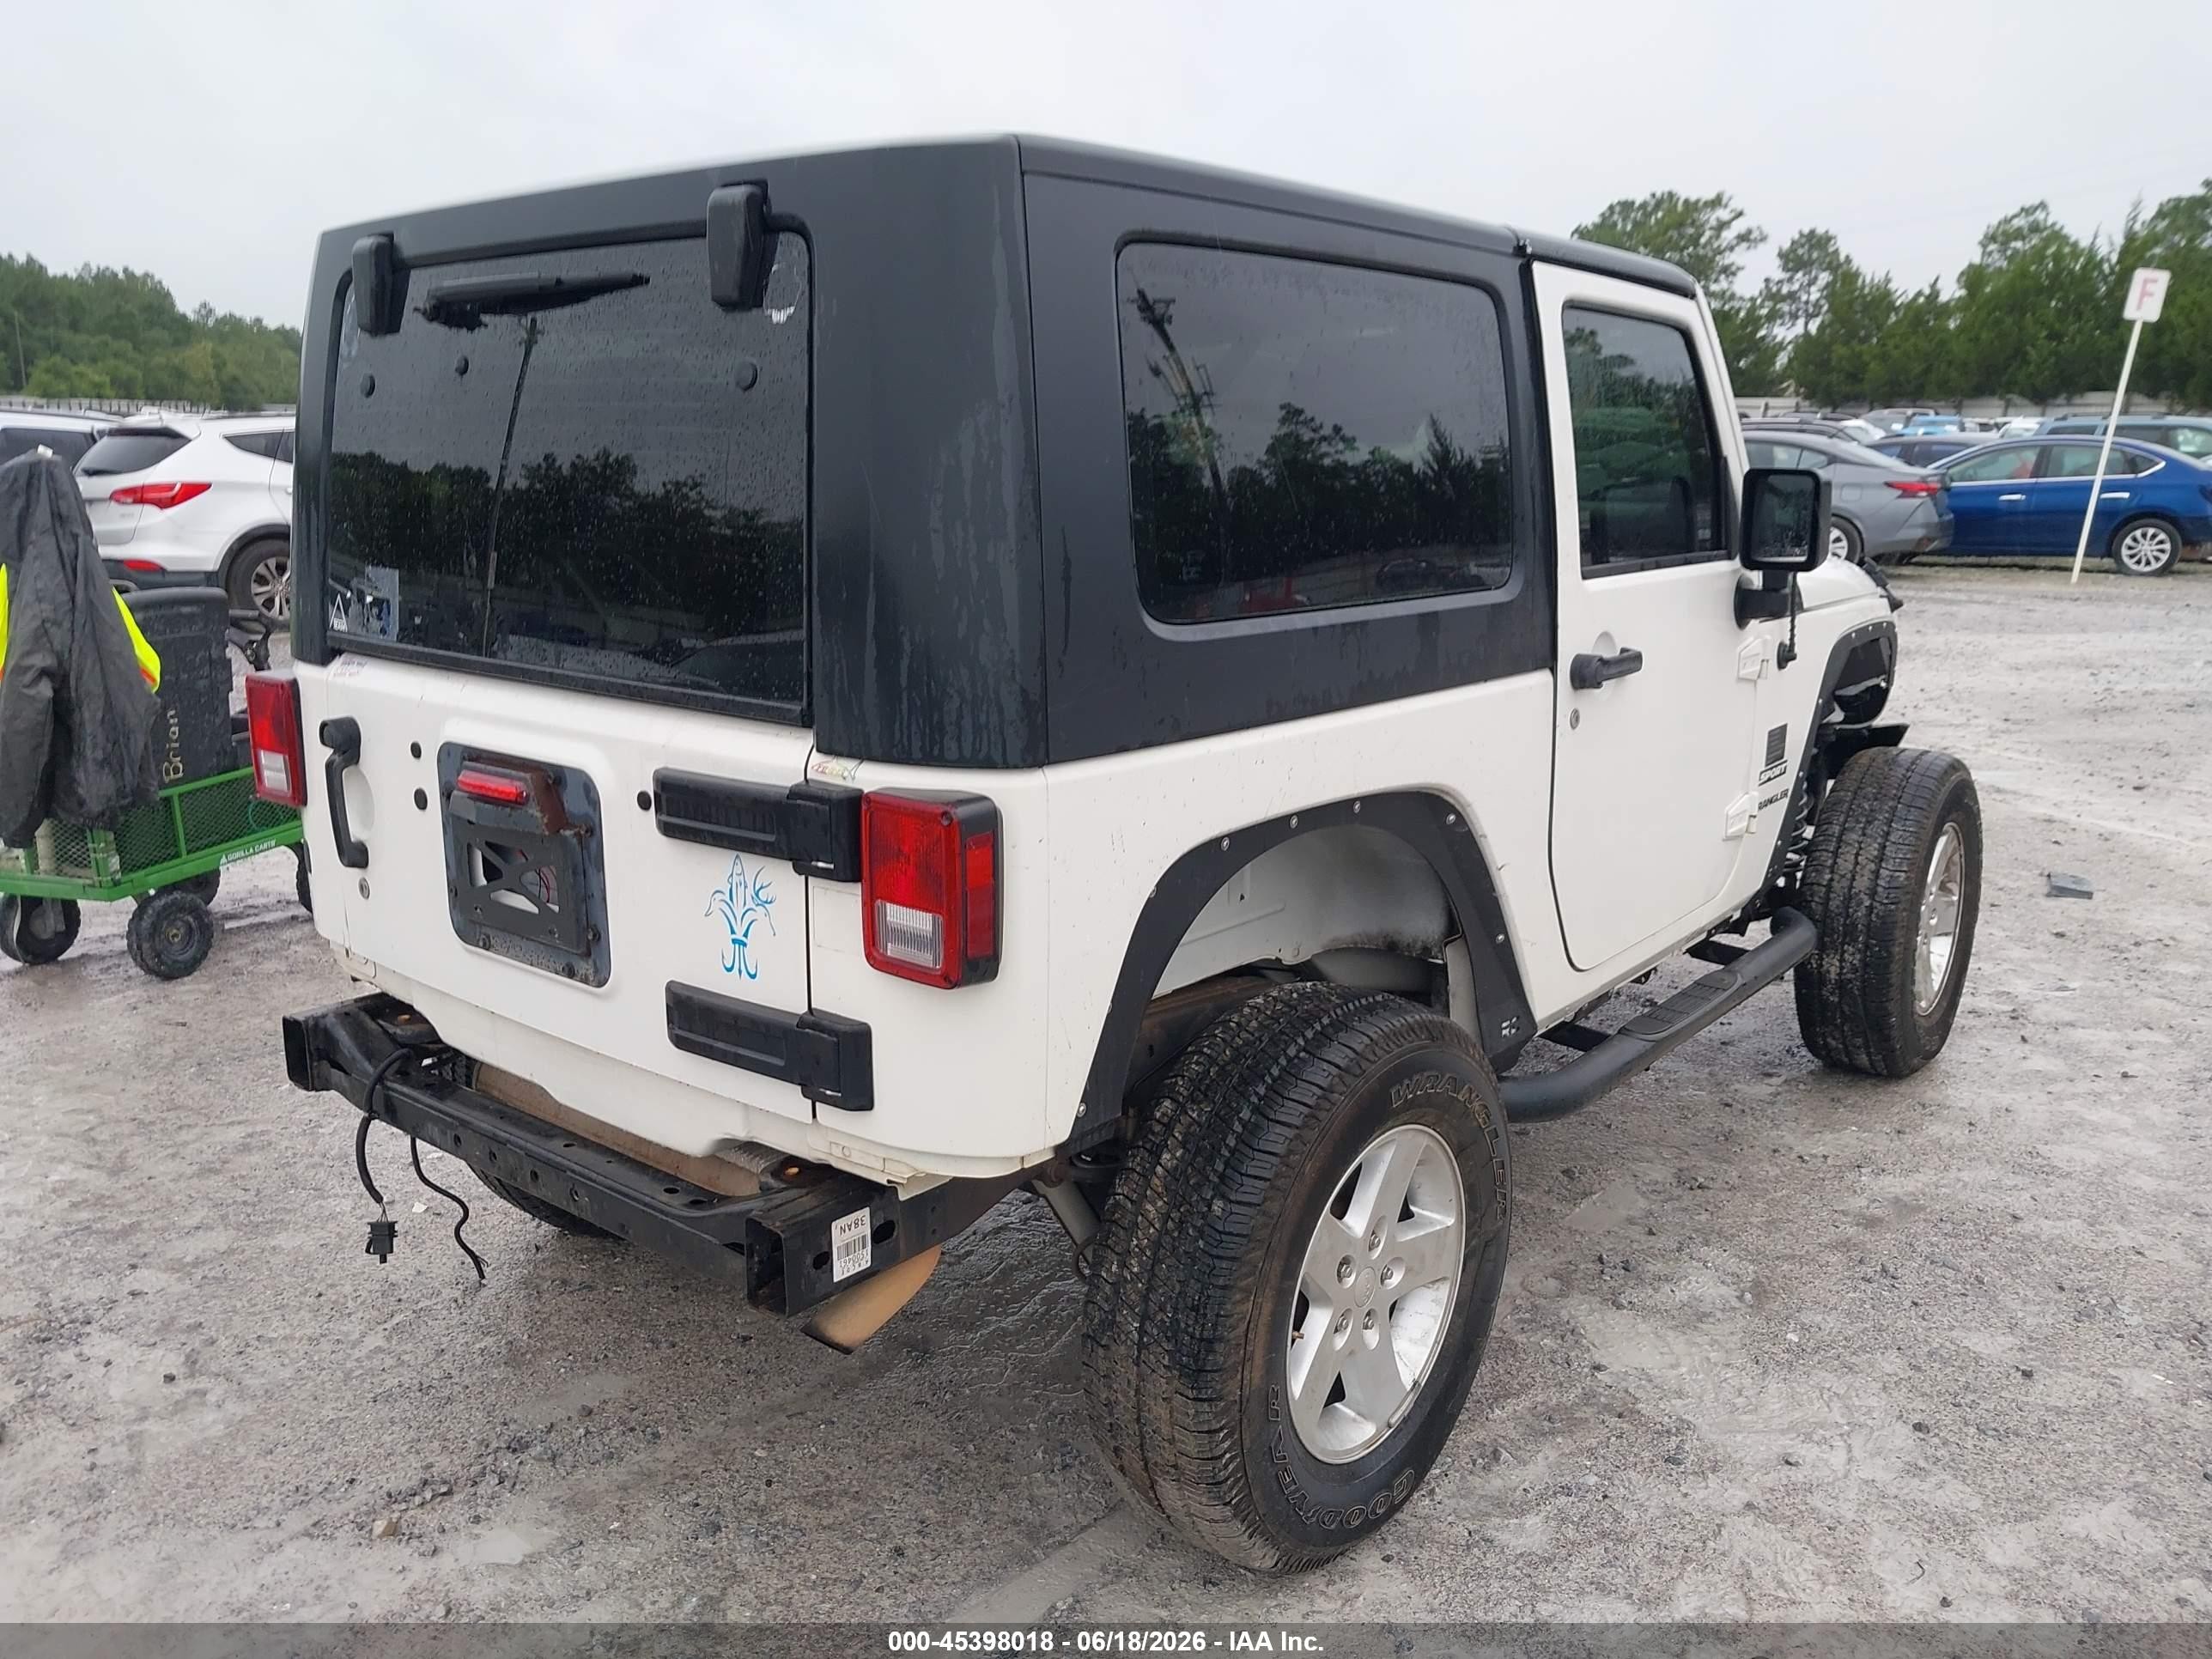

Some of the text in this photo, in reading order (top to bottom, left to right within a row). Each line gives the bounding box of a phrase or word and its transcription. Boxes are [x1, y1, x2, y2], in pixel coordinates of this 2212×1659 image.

[2136, 277, 2159, 312] F
[162, 708, 184, 784] Brian
[1757, 788, 1789, 811] RANGLER
[1390, 1072, 1507, 1221] WRANGLER
[1268, 1383, 1415, 1530] GOODYEAR
